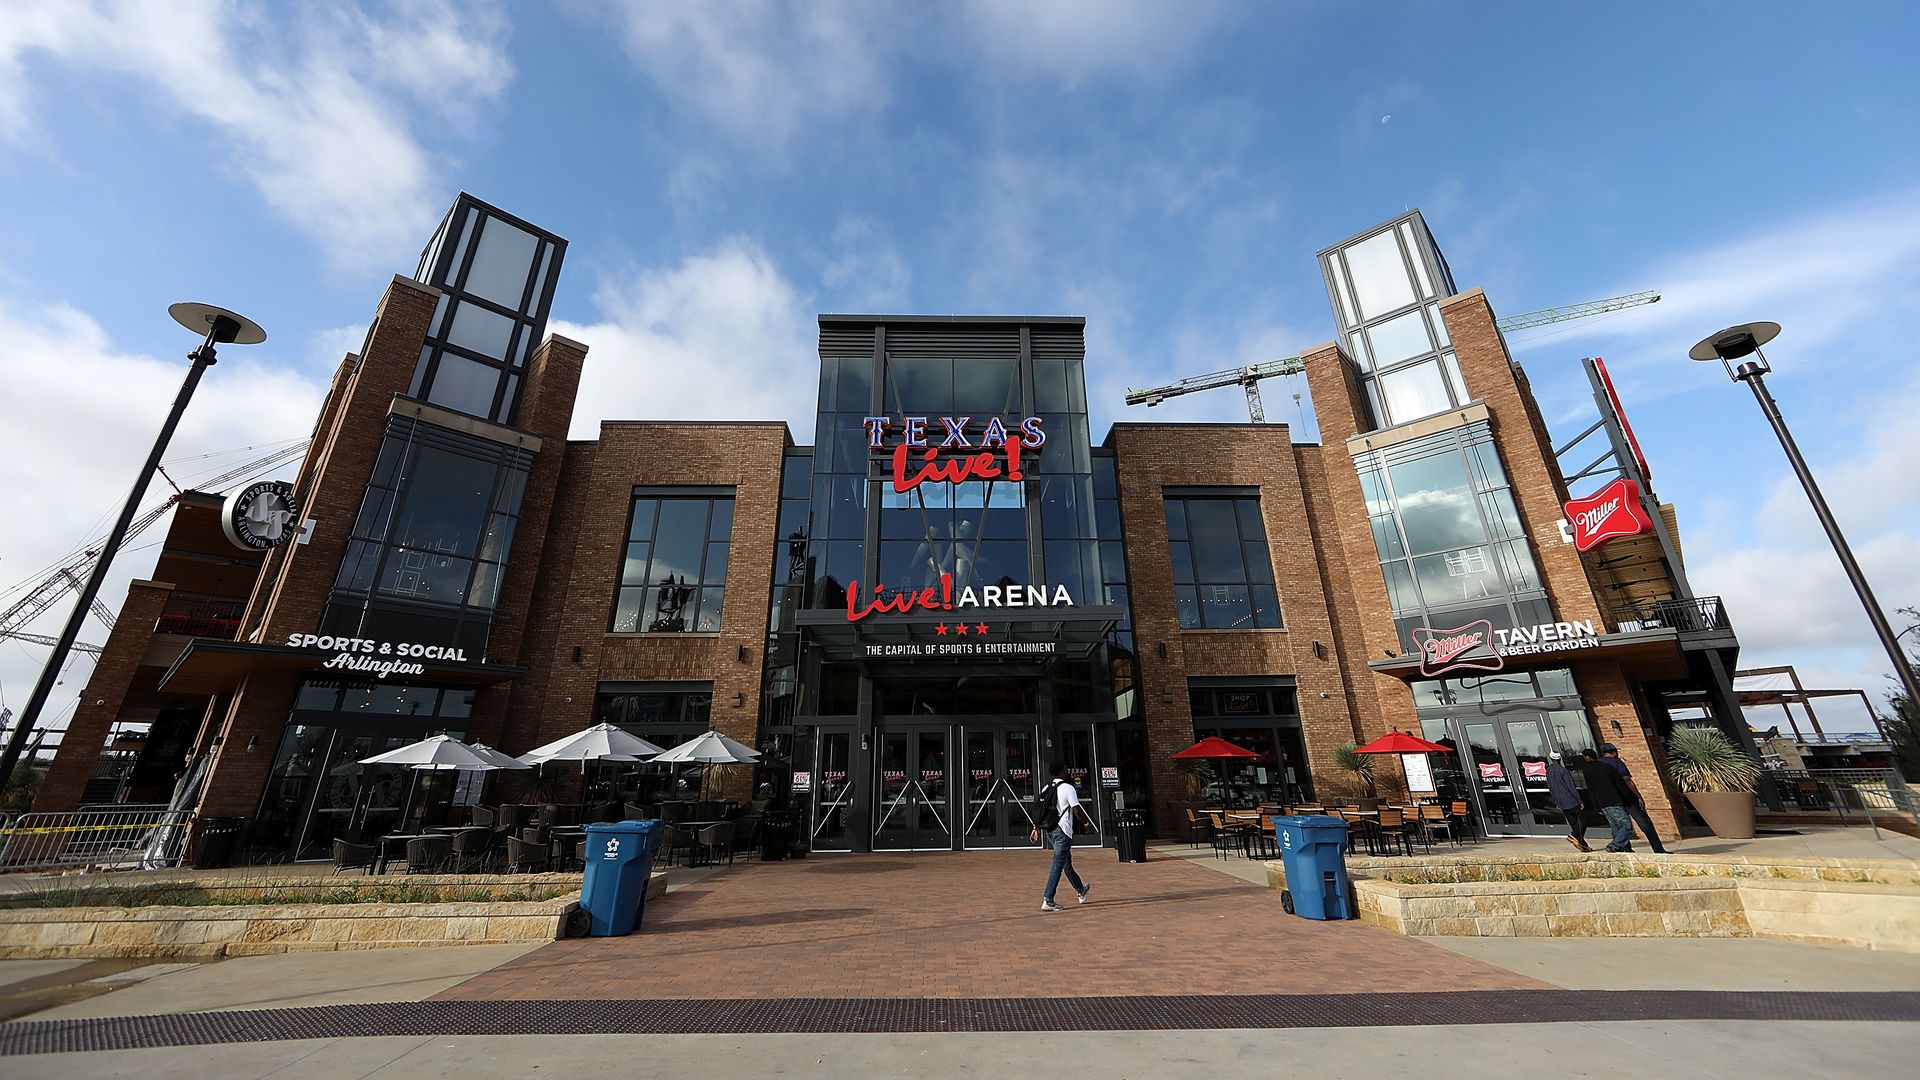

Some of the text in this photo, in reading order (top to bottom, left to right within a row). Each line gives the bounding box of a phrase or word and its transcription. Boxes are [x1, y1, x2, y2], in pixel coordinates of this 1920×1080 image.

[863, 416, 1046, 448] TEXAS
[893, 436, 1023, 492] Live!
[246, 484, 274, 502] SPORTS
[1576, 497, 1620, 534] Miller
[272, 530, 291, 546] TEXAS
[847, 573, 1074, 621] Live! ARENA
[286, 633, 467, 662] SPORTS & SOCIAL
[866, 642, 1056, 655] THE CAPITAL OF SPORTS & ENTERTAINMENT
[1424, 619, 1596, 661] Miller TAVERN
[1542, 638, 1600, 652] GARDEN
[324, 652, 424, 678] Arlington
